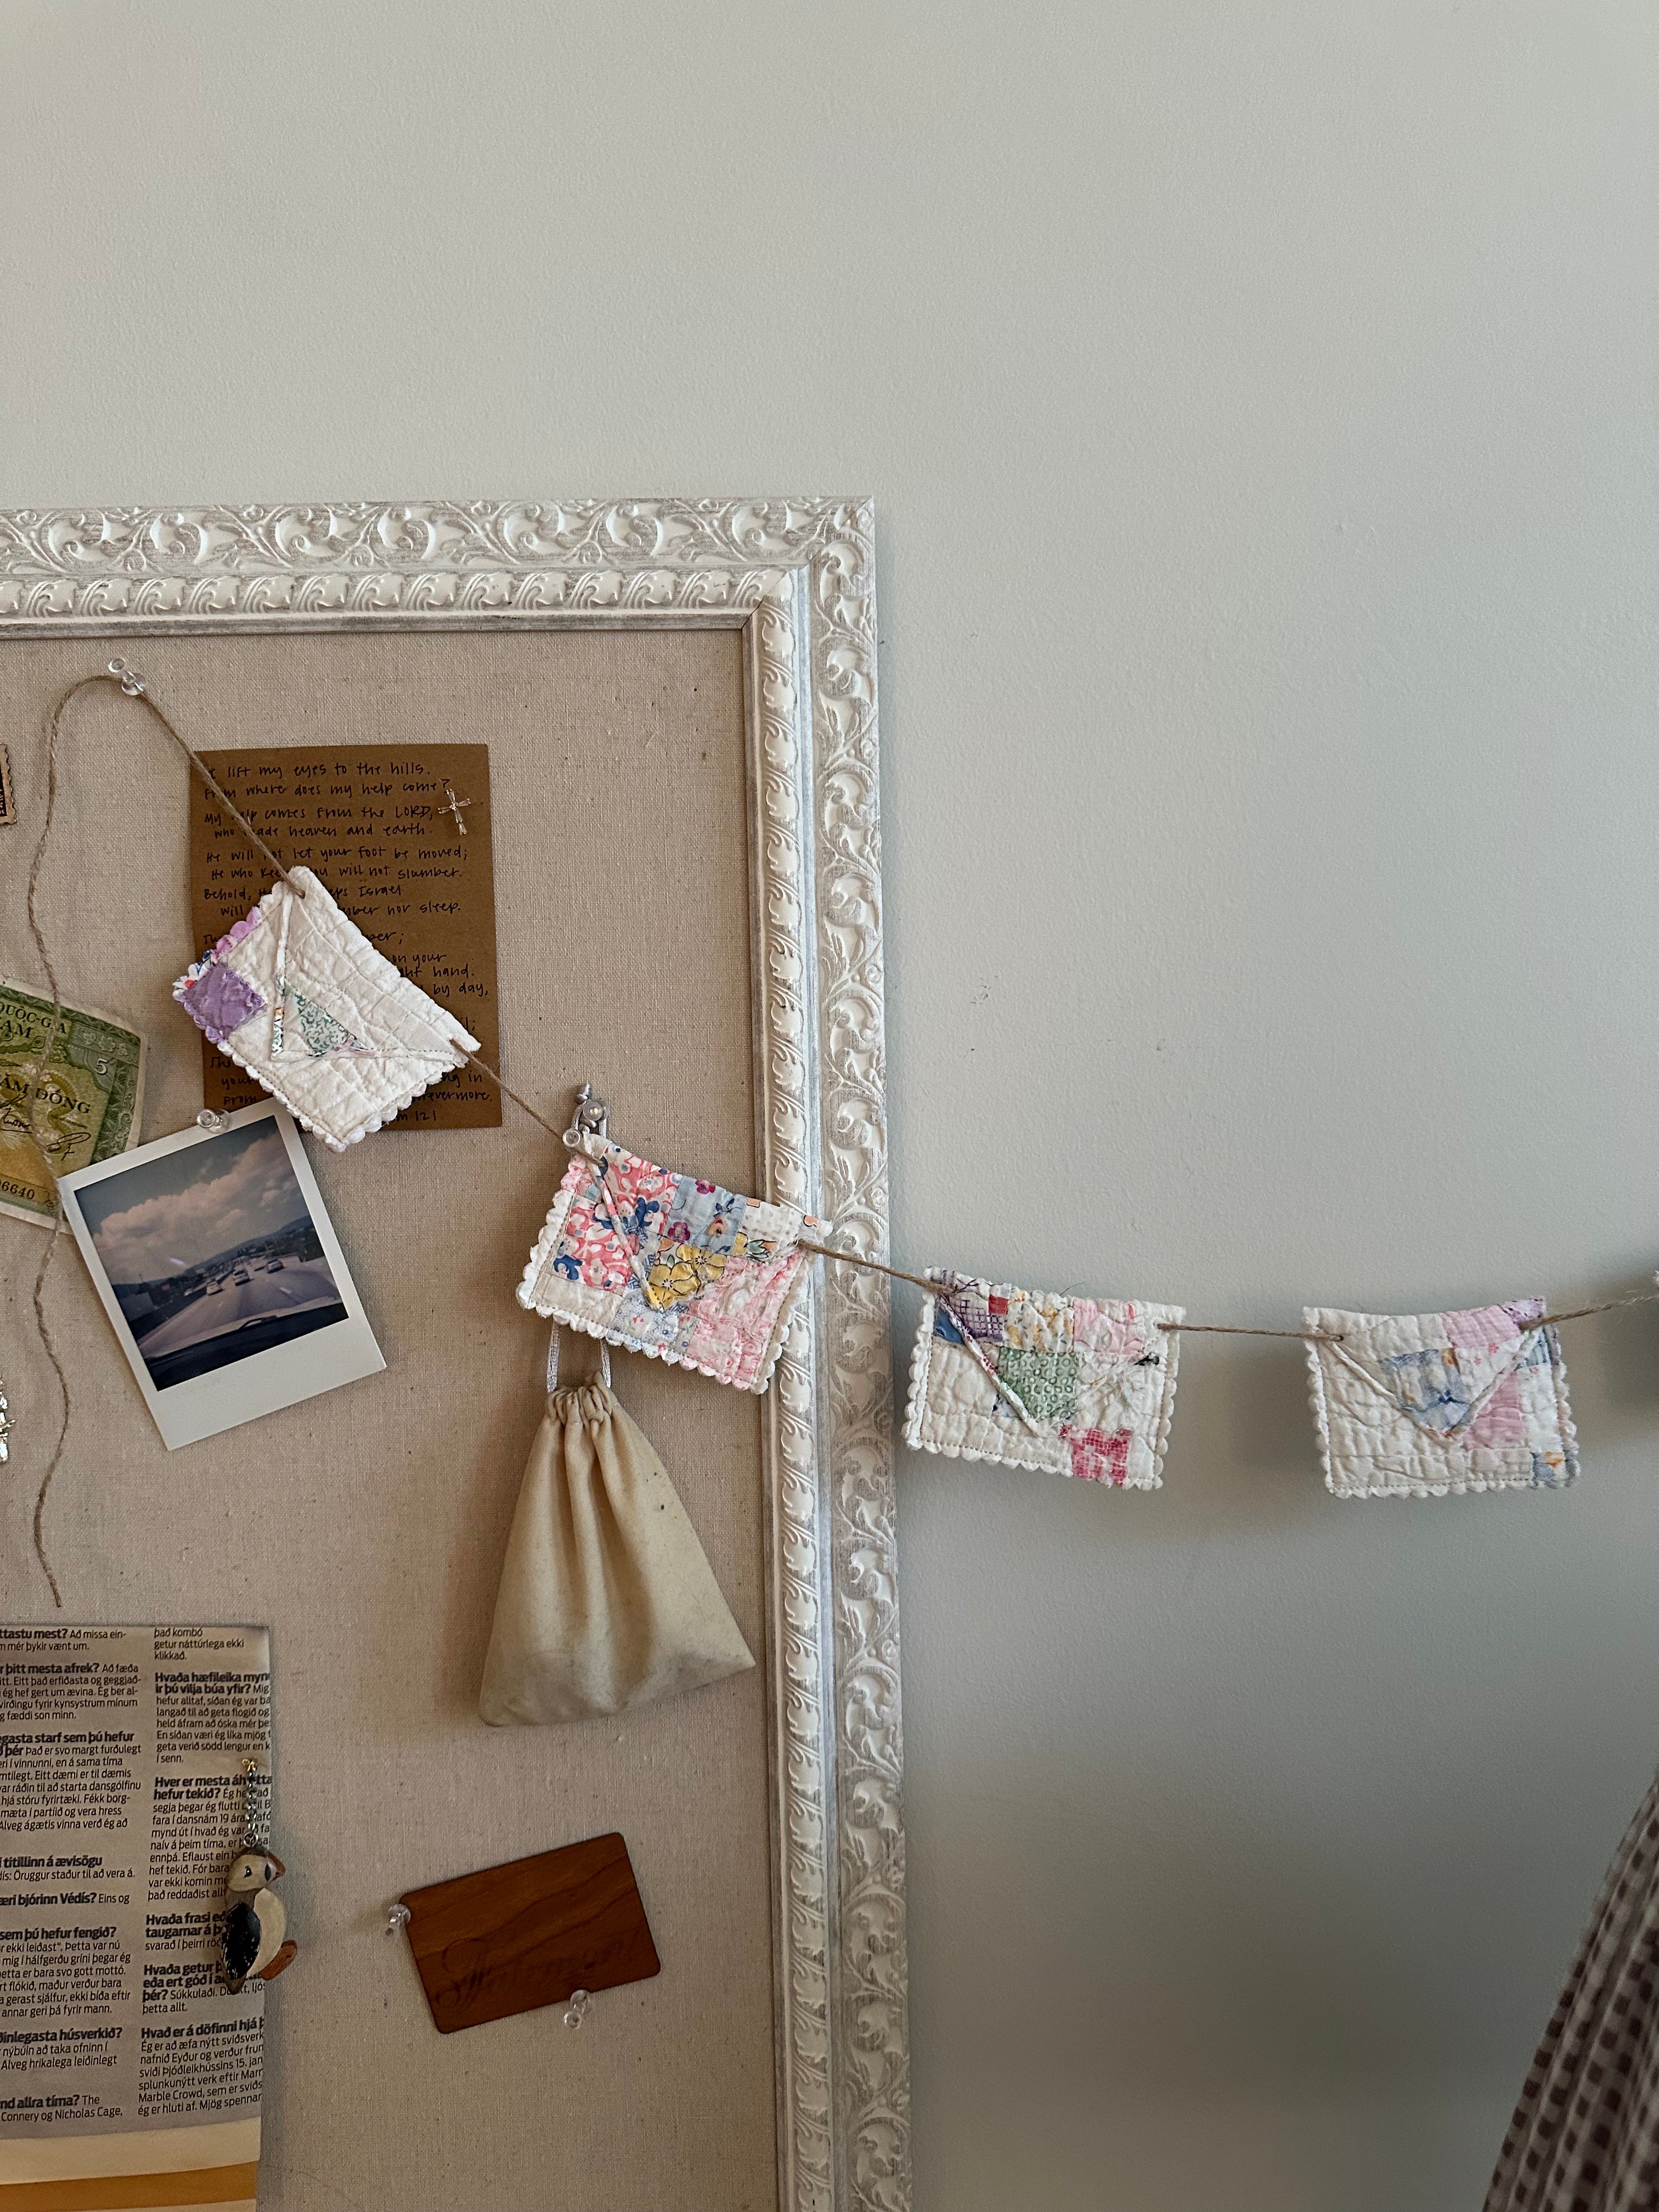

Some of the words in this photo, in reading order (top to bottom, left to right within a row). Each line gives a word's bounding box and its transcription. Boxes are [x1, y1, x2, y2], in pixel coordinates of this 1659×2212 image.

[228, 766, 251, 777] lift
[259, 766, 283, 779] my
[294, 764, 326, 778] eyes
[335, 763, 347, 776] to
[357, 762, 381, 775] the
[391, 762, 430, 775] hills.
[246, 785, 286, 796] where
[295, 784, 320, 796] does
[331, 785, 352, 798] my
[362, 782, 393, 796] help
[403, 778, 450, 792] come?
[205, 813, 221, 826] My
[265, 809, 306, 819] comes
[362, 806, 384, 817] the
[396, 805, 433, 821] LORD,
[215, 828, 234, 839] who
[289, 826, 336, 837] heaven
[347, 823, 373, 836] and
[383, 822, 432, 836] earth.
[207, 852, 220, 863] He
[231, 849, 253, 861] will
[293, 847, 313, 859] let
[320, 848, 351, 862] your
[394, 848, 409, 860] be
[418, 845, 467, 860] moved;
[211, 868, 223, 881] He
[231, 868, 253, 878] who
[339, 865, 363, 876] will
[369, 865, 390, 877] not
[398, 867, 462, 879] slumber.
[204, 887, 251, 901] Behold,
[359, 885, 402, 897] Israel
[221, 905, 243, 917] will
[388, 905, 411, 916] nor
[420, 900, 461, 915] sleep.
[392, 954, 407, 963] on
[413, 953, 447, 967] your
[433, 963, 475, 978] hand.
[433, 984, 450, 997] by
[459, 982, 488, 997] day,
[94, 1058, 109, 1075] 5
[468, 1070, 482, 1082] in
[34, 1628, 67, 1639] mest?
[70, 1629, 81, 1639] Að
[83, 1629, 108, 1639] missa
[110, 1629, 126, 1639] ein-
[154, 1627, 171, 1639] það
[173, 1626, 203, 1637] kombó
[7, 1642, 24, 1651] mér
[26, 1641, 47, 1652] þykir
[49, 1642, 71, 1651] vænt
[73, 1642, 89, 1650] um.
[154, 1640, 178, 1650] getur
[179, 1639, 224, 1650] náttúrlega
[226, 1639, 244, 1647] ekki
[155, 1651, 187, 1660] klikkað.
[6, 1663, 26, 1675] þitt
[28, 1663, 63, 1674] mesta
[64, 1663, 100, 1674] afrek?
[102, 1664, 114, 1673] Að
[116, 1664, 138, 1673] fæða
[14, 1676, 29, 1686] Eitt
[31, 1676, 47, 1686] það
[49, 1675, 89, 1685] erfiðasta
[91, 1677, 102, 1686] og
[104, 1675, 142, 1686] geggjað-
[155, 1672, 189, 1682] Hvaða
[192, 1672, 241, 1682] hæfileika
[165, 1684, 178, 1695] þú
[180, 1684, 202, 1695] vilja
[204, 1684, 225, 1694] búa
[227, 1684, 251, 1695] yfir?
[35, 1732, 62, 1743] starf
[63, 1734, 87, 1743] sem
[88, 1731, 103, 1744] þú
[104, 1731, 134, 1742] hefur
[5, 1745, 24, 1758] þér
[44, 1747, 53, 1755] er
[55, 1747, 70, 1755] svo
[72, 1746, 99, 1756] margt
[101, 1744, 142, 1755] furðulegt
[155, 1776, 181, 1787] Hver
[182, 1778, 194, 1787] er
[195, 1775, 230, 1786] mesta
[154, 1788, 184, 1800] hefur
[186, 1787, 220, 1799] tekið?
[223, 1787, 234, 1799] Ég
[3, 1857, 45, 1868] titillinn
[46, 1855, 54, 1867] á
[14, 1869, 50, 1882] Öruggur
[52, 1870, 80, 1879] staður
[82, 1869, 91, 1878] til
[93, 1869, 104, 1878] að
[106, 1870, 125, 1878] vera
[127, 1867, 136, 1878] á.
[18, 1893, 58, 1907] bjórinn
[60, 1892, 97, 1904] Védís?
[98, 1894, 116, 1904] Eins
[119, 1894, 129, 1904] og
[146, 1914, 183, 1926] Hvaða
[185, 1912, 211, 1923] frasi
[25, 1928, 39, 1942] þú
[41, 1927, 72, 1939] hefur
[74, 1927, 117, 1940] fengið?
[143, 2002, 168, 2015] þetta
[170, 2002, 188, 2012] allt.
[59, 2027, 122, 2041] húsverkið?
[142, 2027, 171, 2039] Hvað
[173, 2029, 185, 2038] er
[186, 2024, 194, 2036] á
[196, 2021, 237, 2035] döfinni
[239, 2017, 257, 2032] hjá
[1, 2060, 27, 2070] Alveg
[29, 2057, 72, 2069] hrikalega
[75, 2055, 117, 2066] leiðinlegt
[17, 2096, 44, 2108] allra
[46, 2095, 80, 2107] tíma?
[82, 2095, 100, 2106] The
[139, 2091, 171, 2102] Marble
[173, 2088, 205, 2100] Crowd,
[1, 2112, 38, 2122] Connery
[41, 2111, 53, 2121] og
[55, 2108, 95, 2119] Nicholas
[97, 2107, 123, 2118] Cage,
[138, 2106, 149, 2117] ég
[151, 2106, 161, 2114] er
[162, 2102, 184, 2113] hluti
[186, 2101, 197, 2111] af.
[200, 2098, 222, 2110] Mjög
